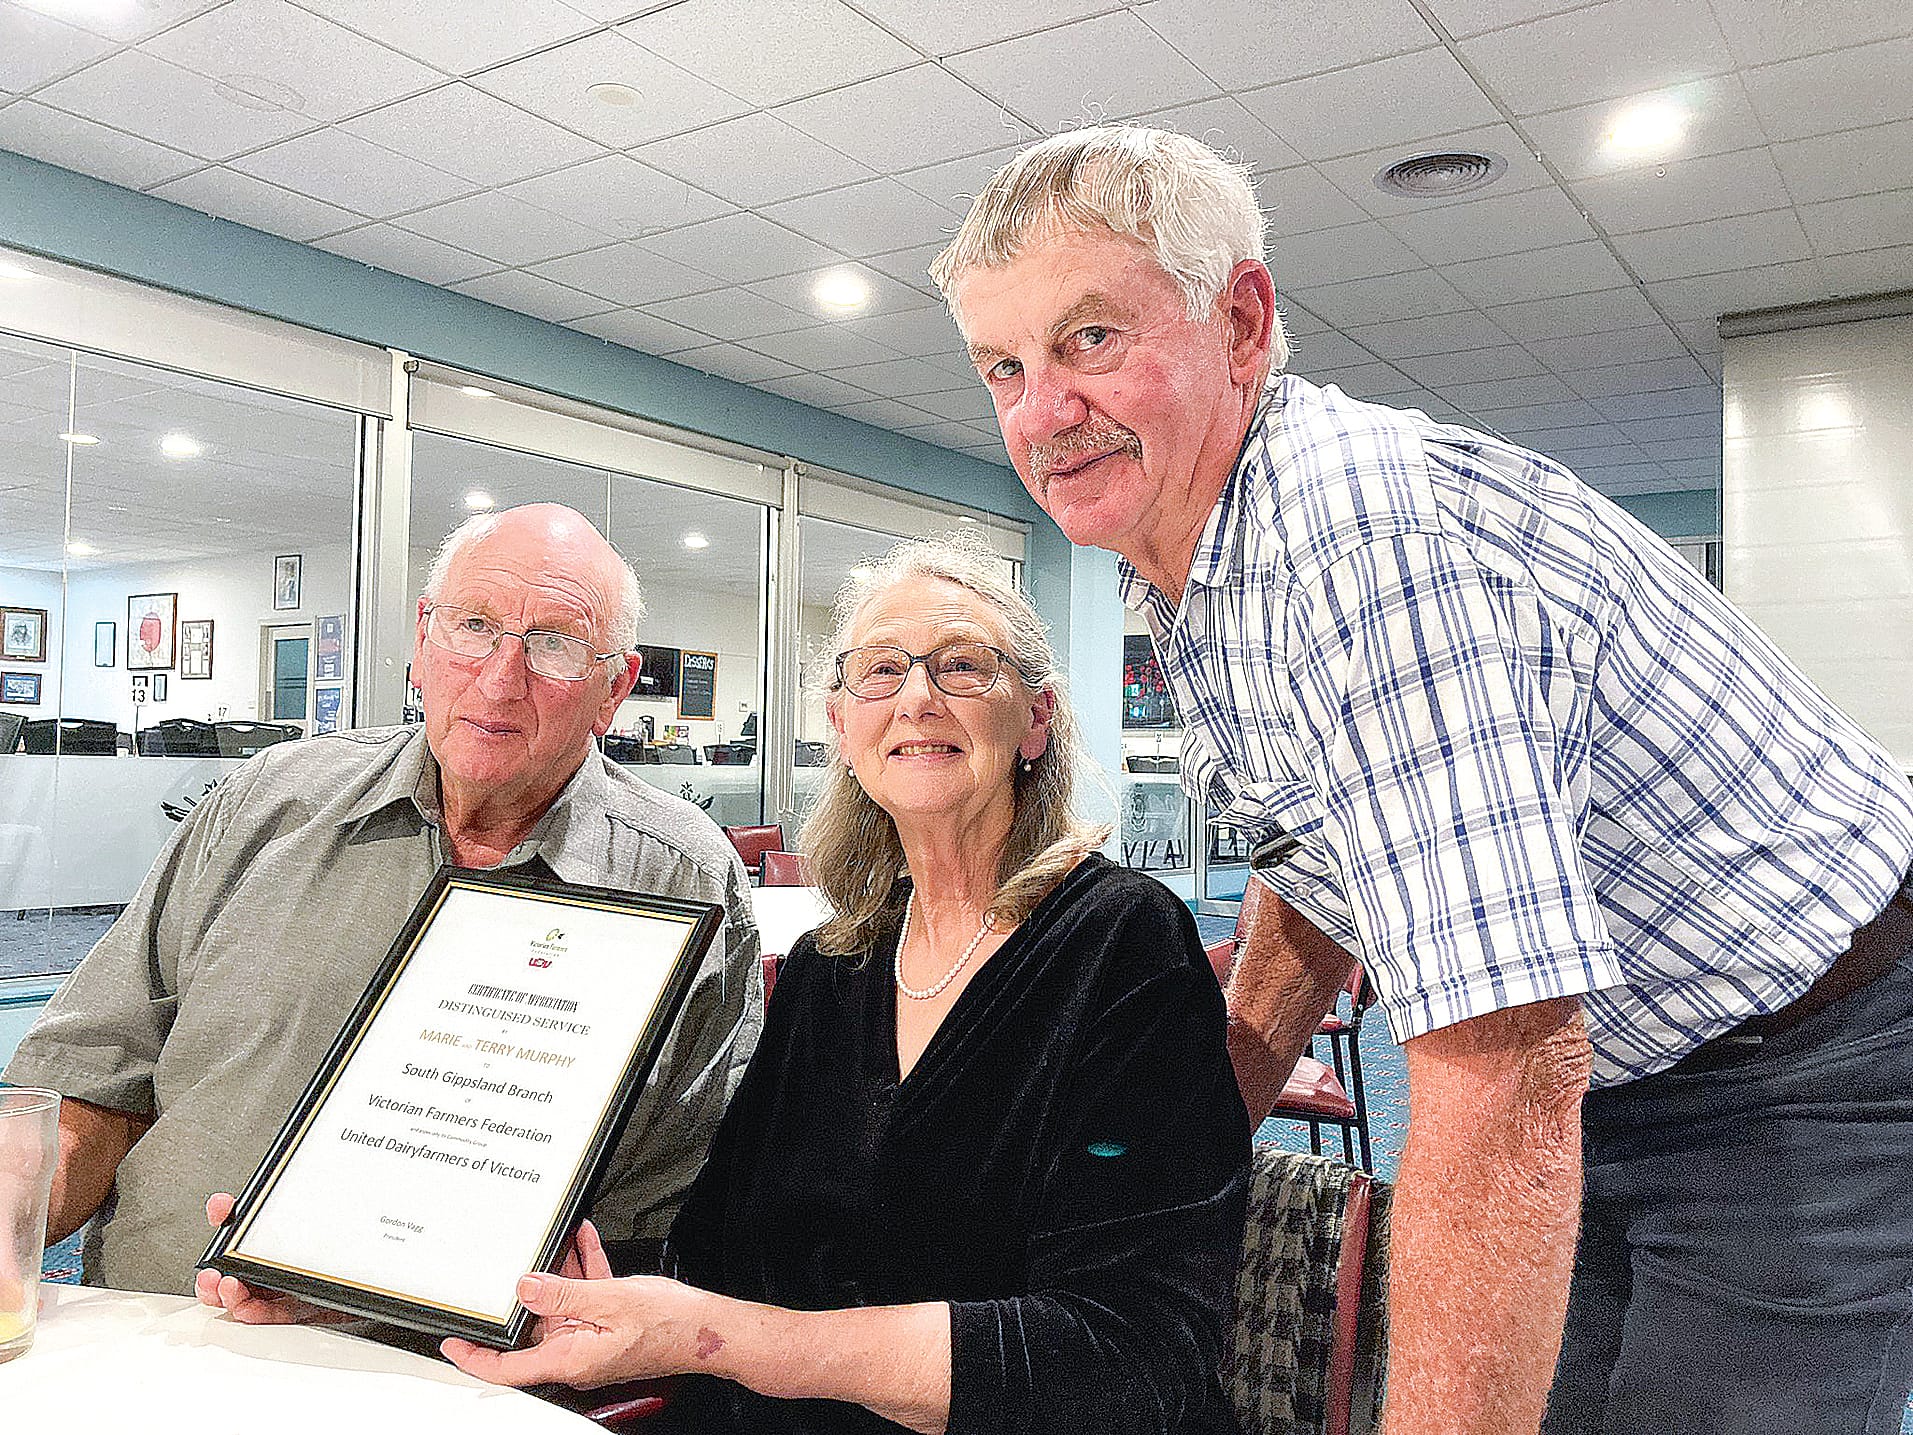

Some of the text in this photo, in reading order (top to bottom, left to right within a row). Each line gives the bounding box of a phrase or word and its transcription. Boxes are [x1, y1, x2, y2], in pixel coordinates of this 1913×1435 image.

[131, 689, 145, 703] 13
[218, 707, 228, 717] 17
[437, 998, 591, 1036] DISTINGUISED SERVICE
[467, 983, 579, 1013] CERTIFICATE OF APPRECIATION
[418, 1028, 462, 1047] MARIE
[475, 1039, 516, 1057] TERRY
[515, 1047, 576, 1069] MURPHY
[401, 1063, 553, 1104] South Gippsland Branch
[368, 1093, 552, 1144] Victorian Farmers Federation
[340, 1127, 541, 1184] United Dairyfarmers of Victoria
[380, 1215, 406, 1227] Gordon
